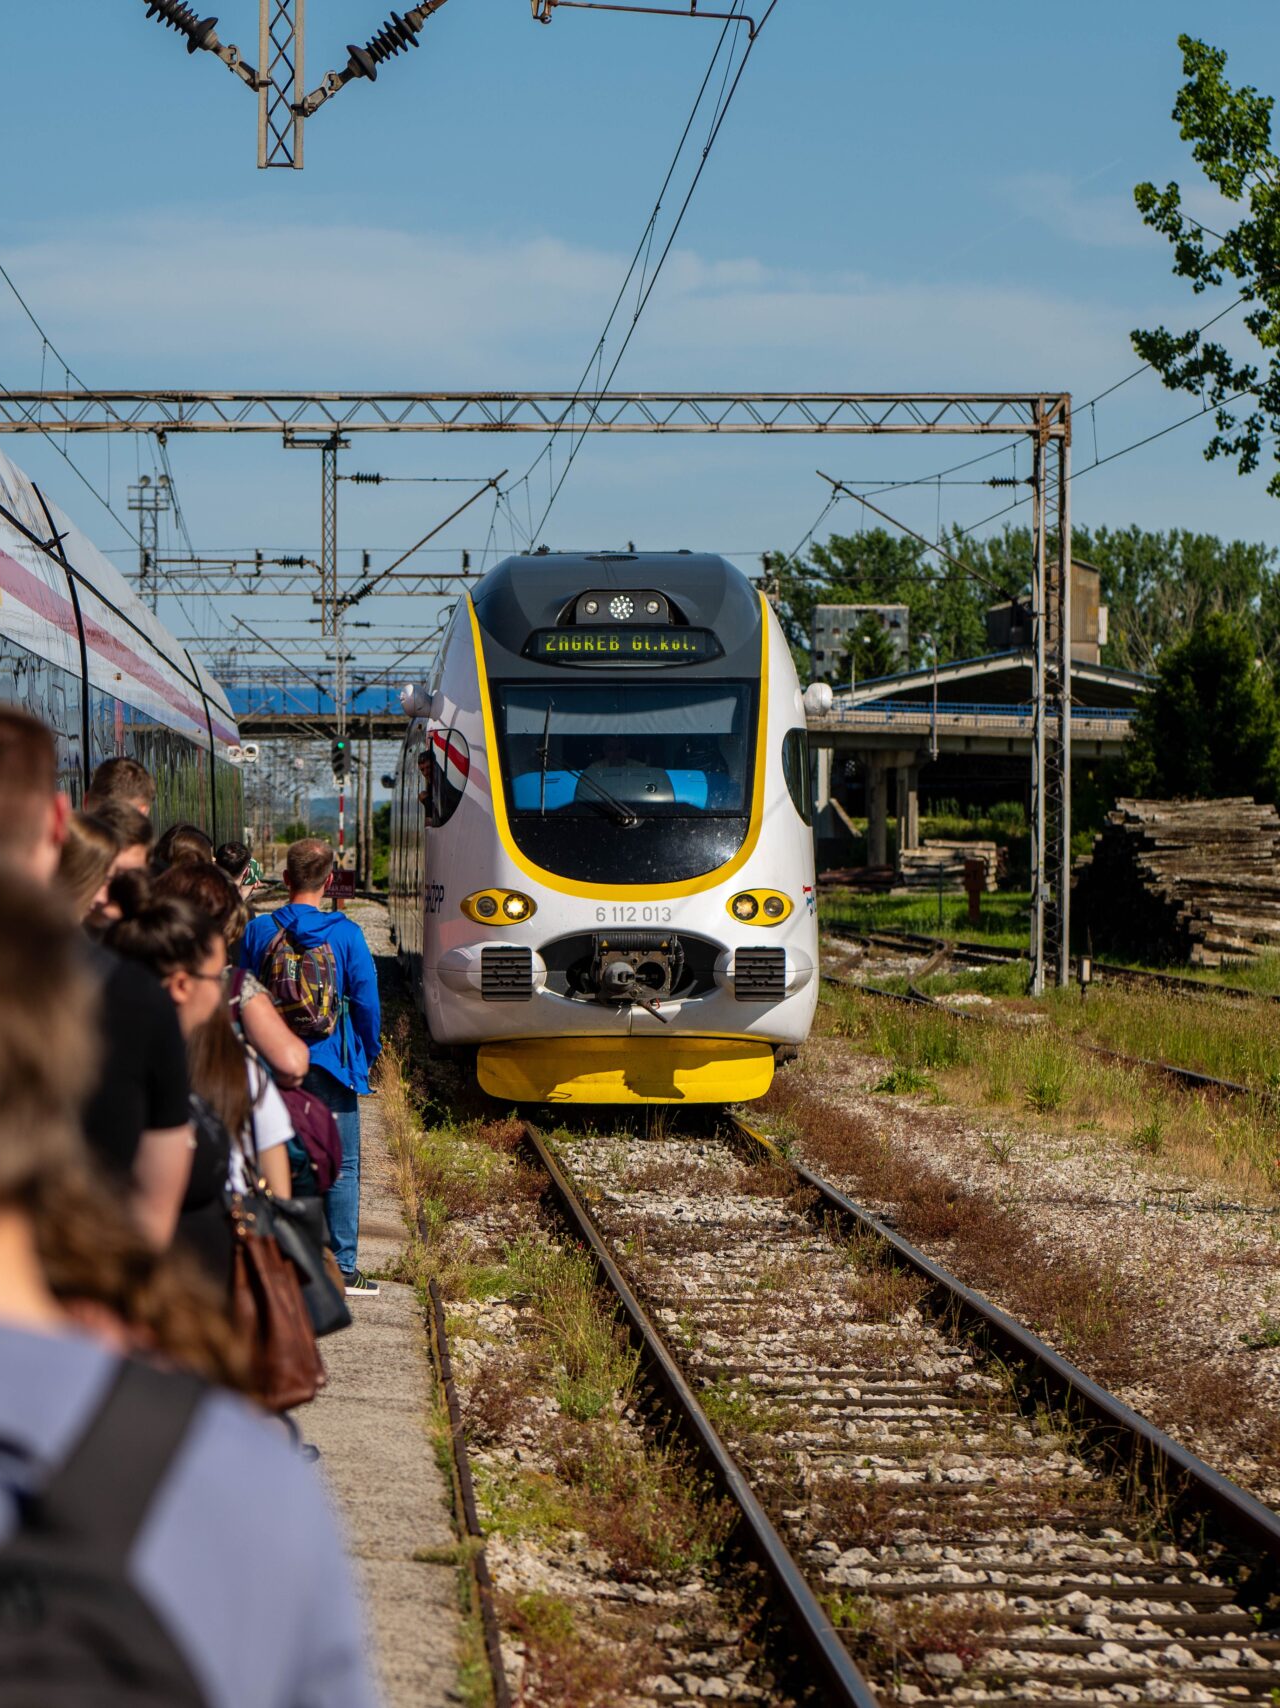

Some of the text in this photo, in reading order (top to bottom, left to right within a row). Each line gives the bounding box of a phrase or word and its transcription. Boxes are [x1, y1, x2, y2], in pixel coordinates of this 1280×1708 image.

[545, 635, 620, 652] ZAGREB
[595, 906, 672, 922] 6 112 013
